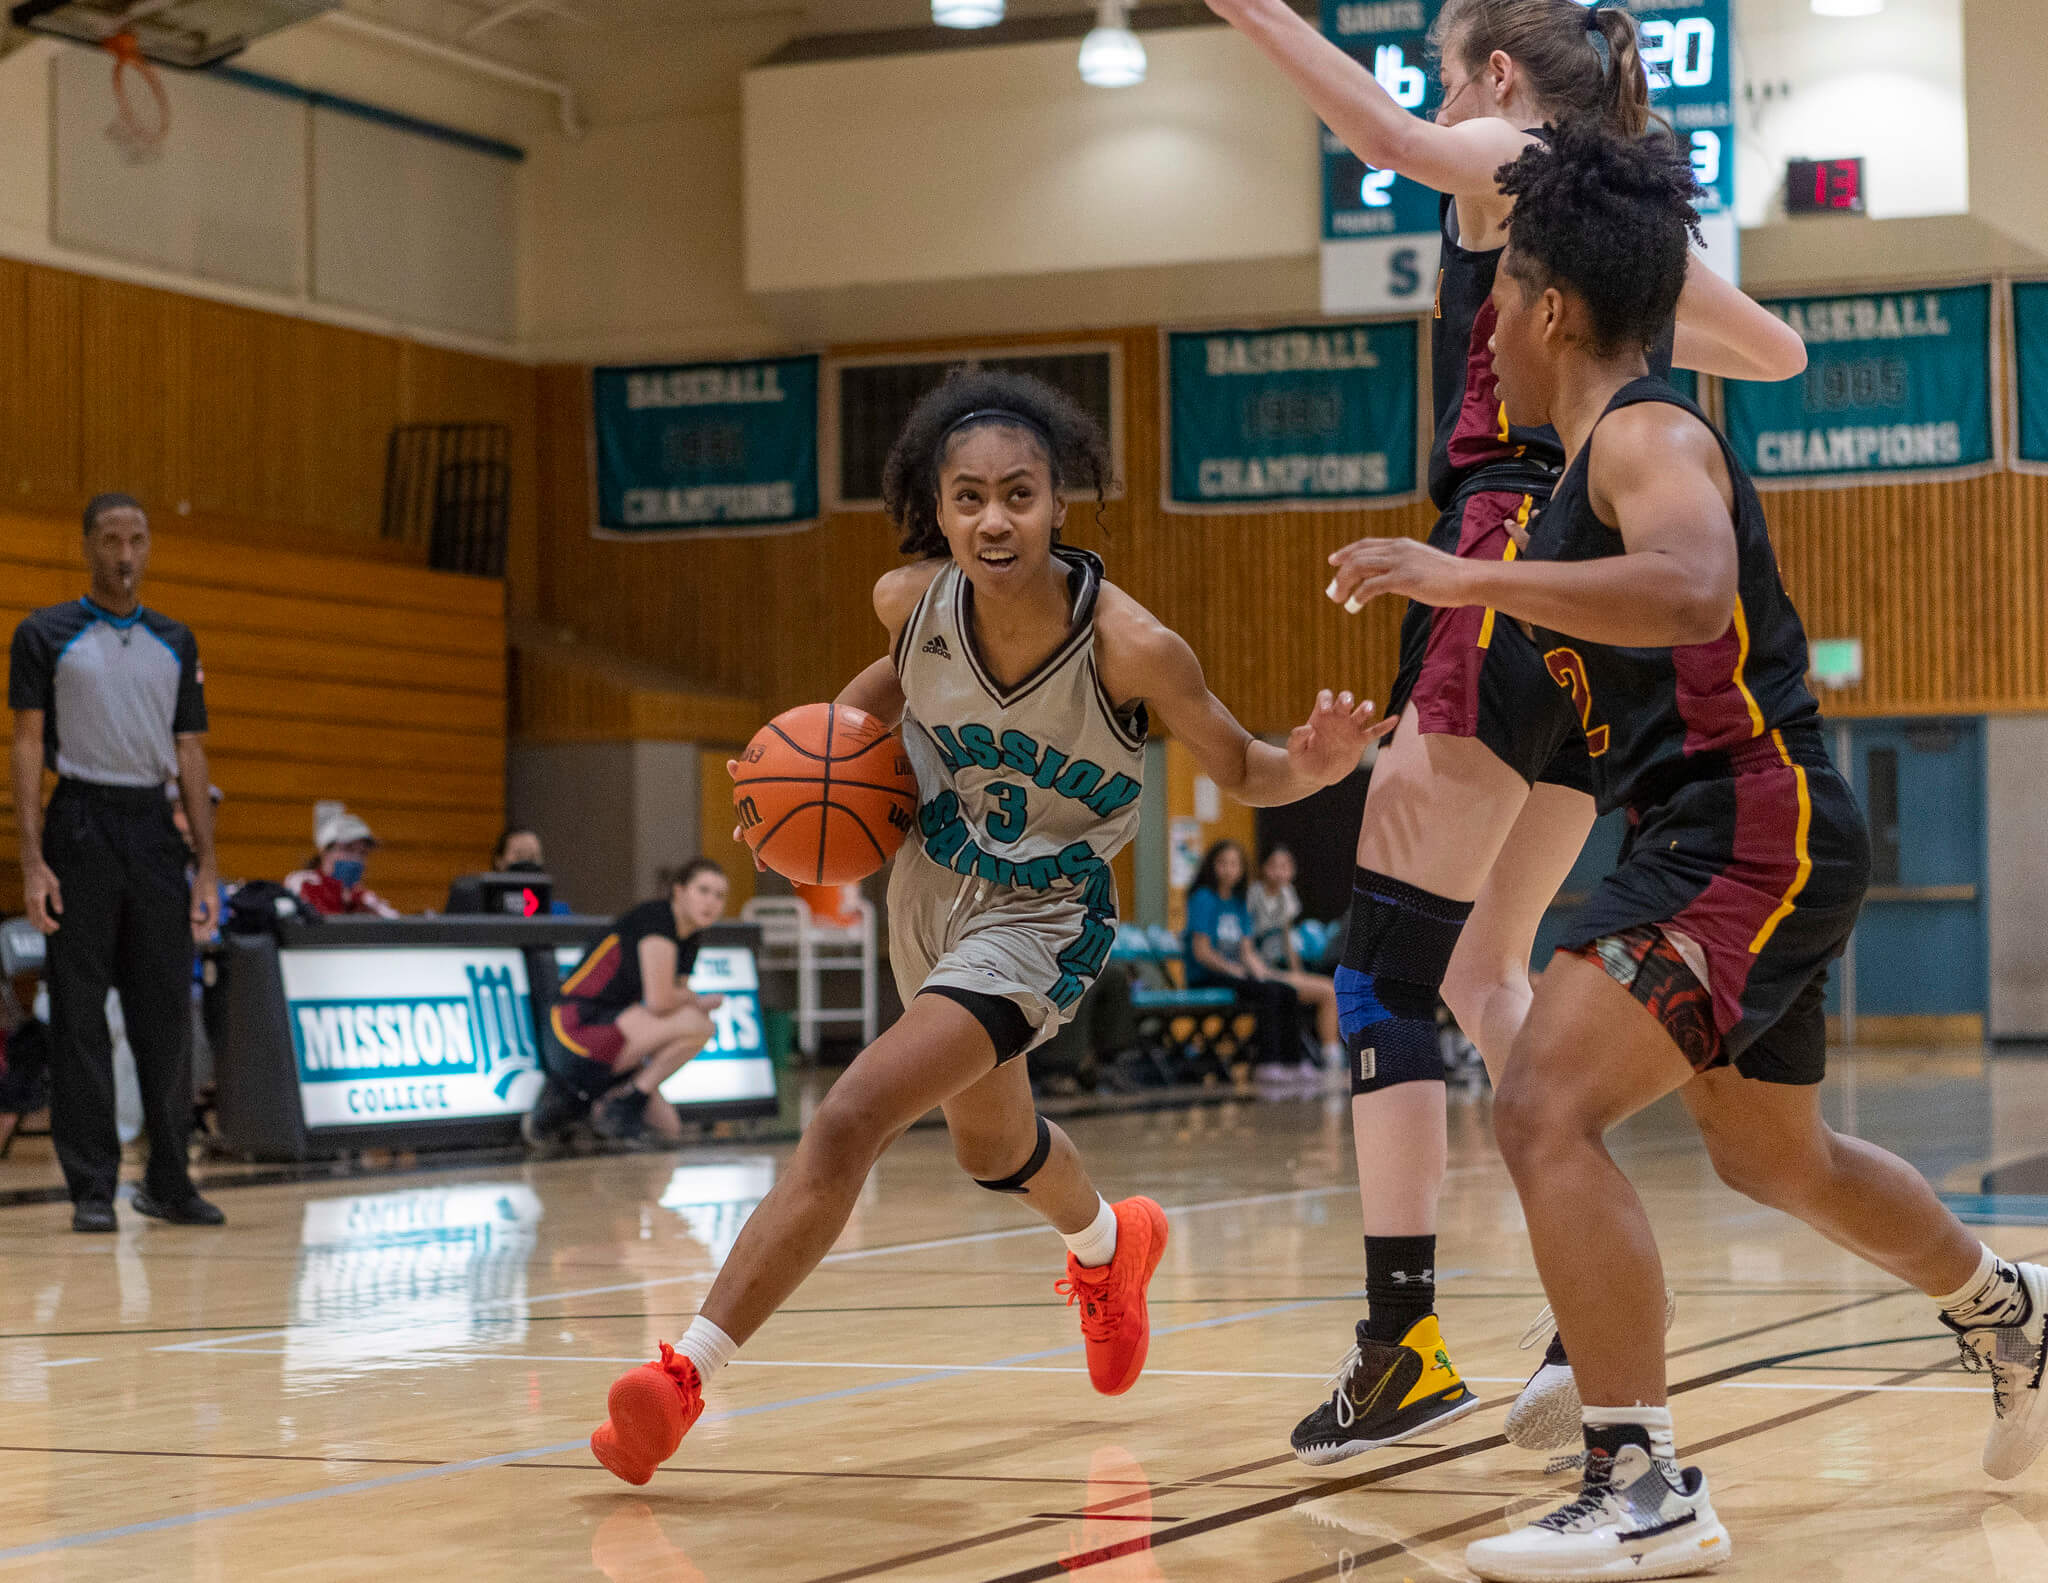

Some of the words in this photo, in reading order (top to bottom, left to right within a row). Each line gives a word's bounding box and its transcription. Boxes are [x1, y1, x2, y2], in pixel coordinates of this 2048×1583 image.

[1640, 17, 1716, 89] 20
[1690, 130, 1721, 184] 3
[1814, 159, 1860, 209] 13
[1768, 294, 1950, 344] ASEBALL
[1206, 330, 1379, 376] BASEBALL
[1756, 420, 1961, 473] CHAMPIONS
[1199, 452, 1388, 496] CHAMPIONS
[922, 645, 952, 661] adidas
[935, 724, 1142, 818] ISSION
[984, 781, 1028, 844] 3
[298, 1001, 475, 1071] MISSION
[347, 1083, 449, 1115] COLLEGE
